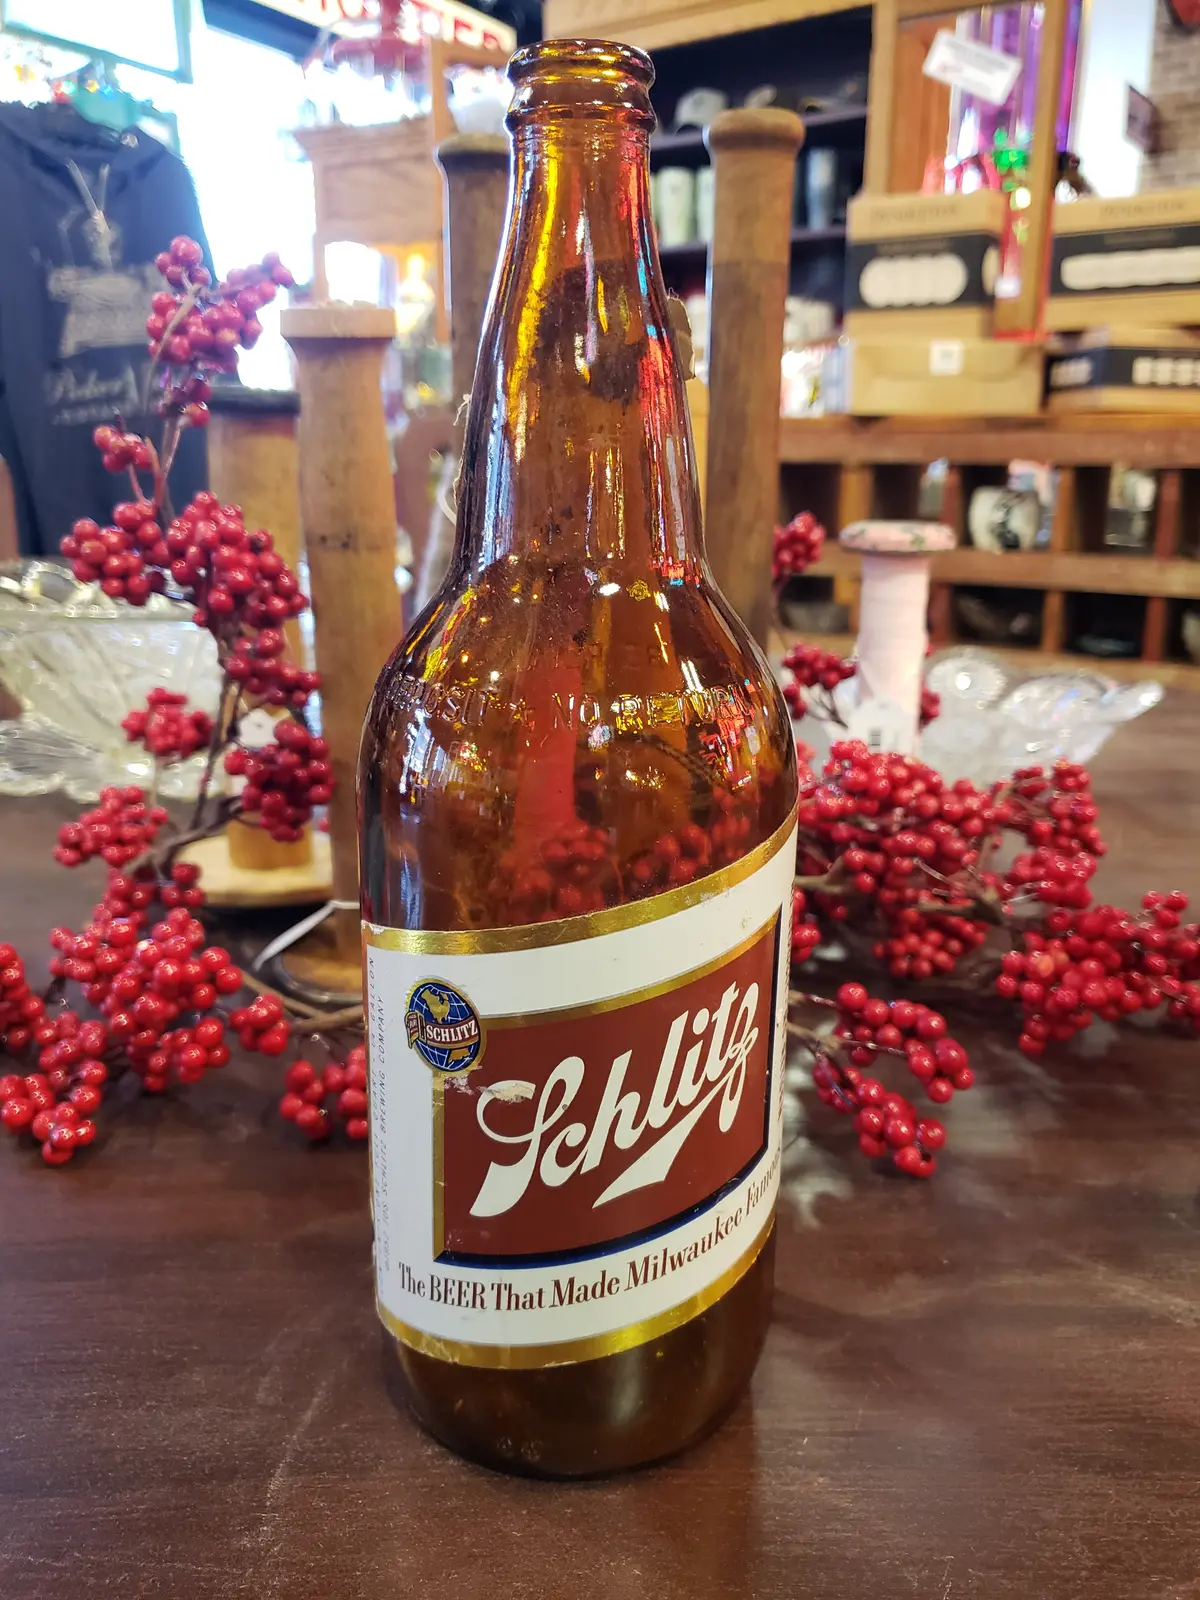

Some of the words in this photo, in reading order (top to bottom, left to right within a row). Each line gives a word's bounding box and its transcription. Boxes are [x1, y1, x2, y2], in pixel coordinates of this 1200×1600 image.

[551, 692, 601, 730] NO
[614, 682, 754, 734] RETURN
[368, 956, 376, 1021] GALLON
[377, 995, 385, 1064] COMPANY
[426, 1019, 479, 1043] SCHLITZ
[378, 1070, 387, 1134] BREWING
[469, 981, 760, 1218] Schlitz
[380, 1139, 388, 1196] SCHLITZ
[398, 1261, 426, 1298] The
[428, 1273, 488, 1310] BEER
[490, 1281, 546, 1311] That
[548, 1270, 621, 1309] Made
[624, 1207, 743, 1292] Milwaukee
